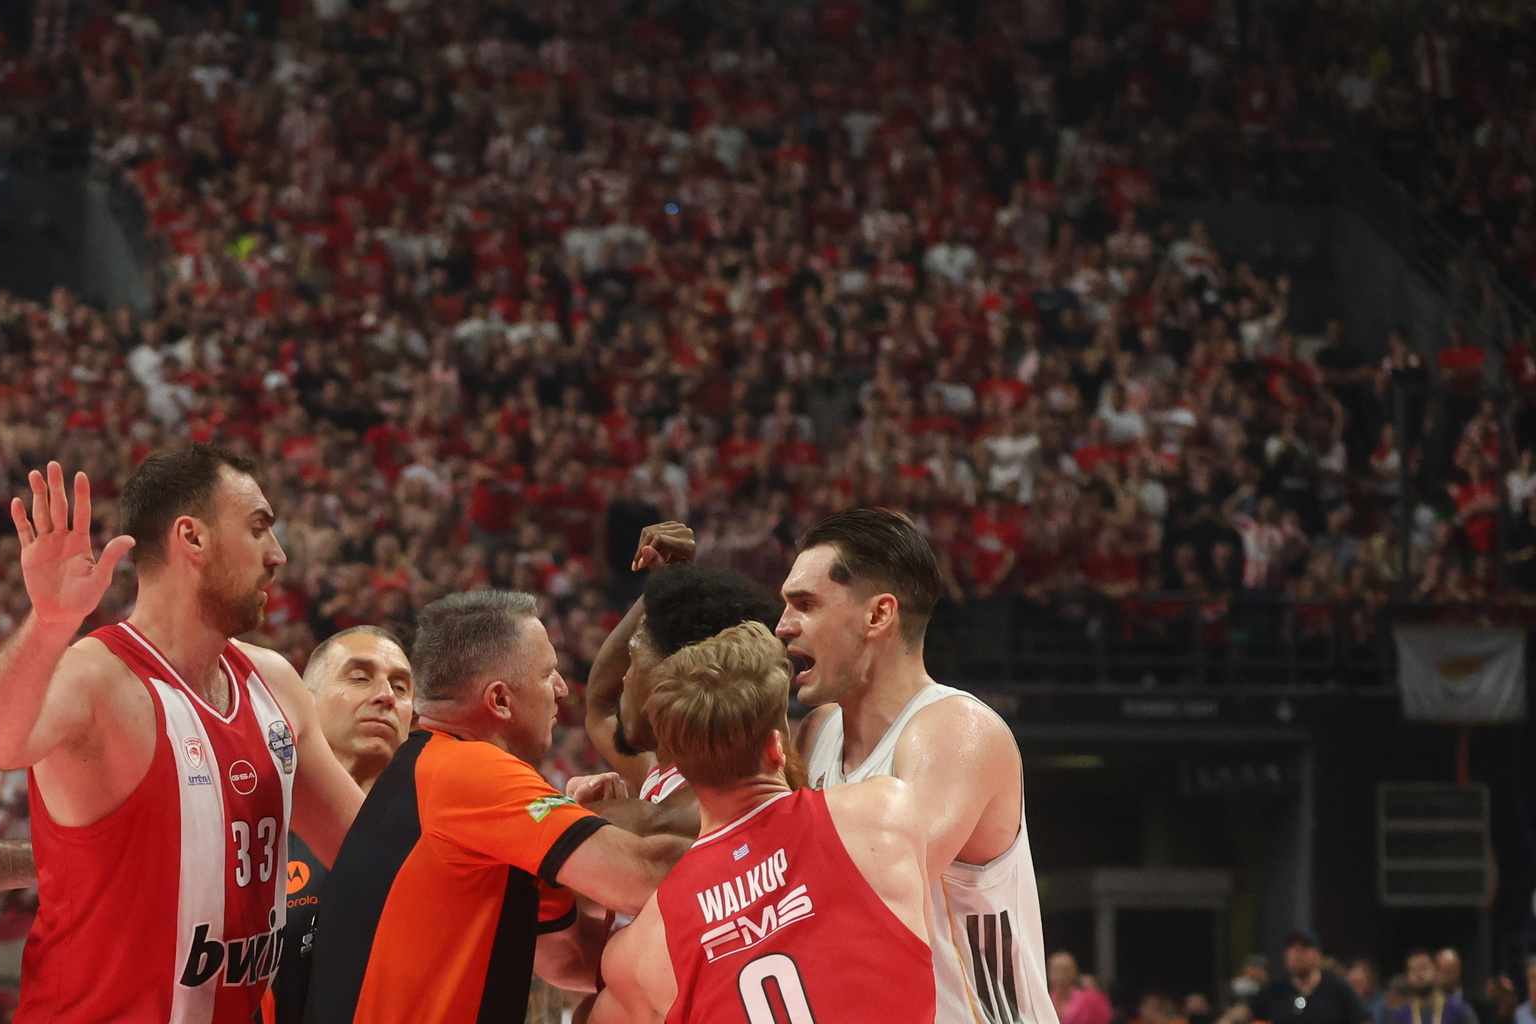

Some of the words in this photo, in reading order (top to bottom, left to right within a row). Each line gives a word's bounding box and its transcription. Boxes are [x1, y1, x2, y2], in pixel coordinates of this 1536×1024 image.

[231, 771, 255, 782] GSA
[231, 816, 277, 888] 33
[696, 848, 788, 924] WALKUP
[700, 884, 815, 962] FMS
